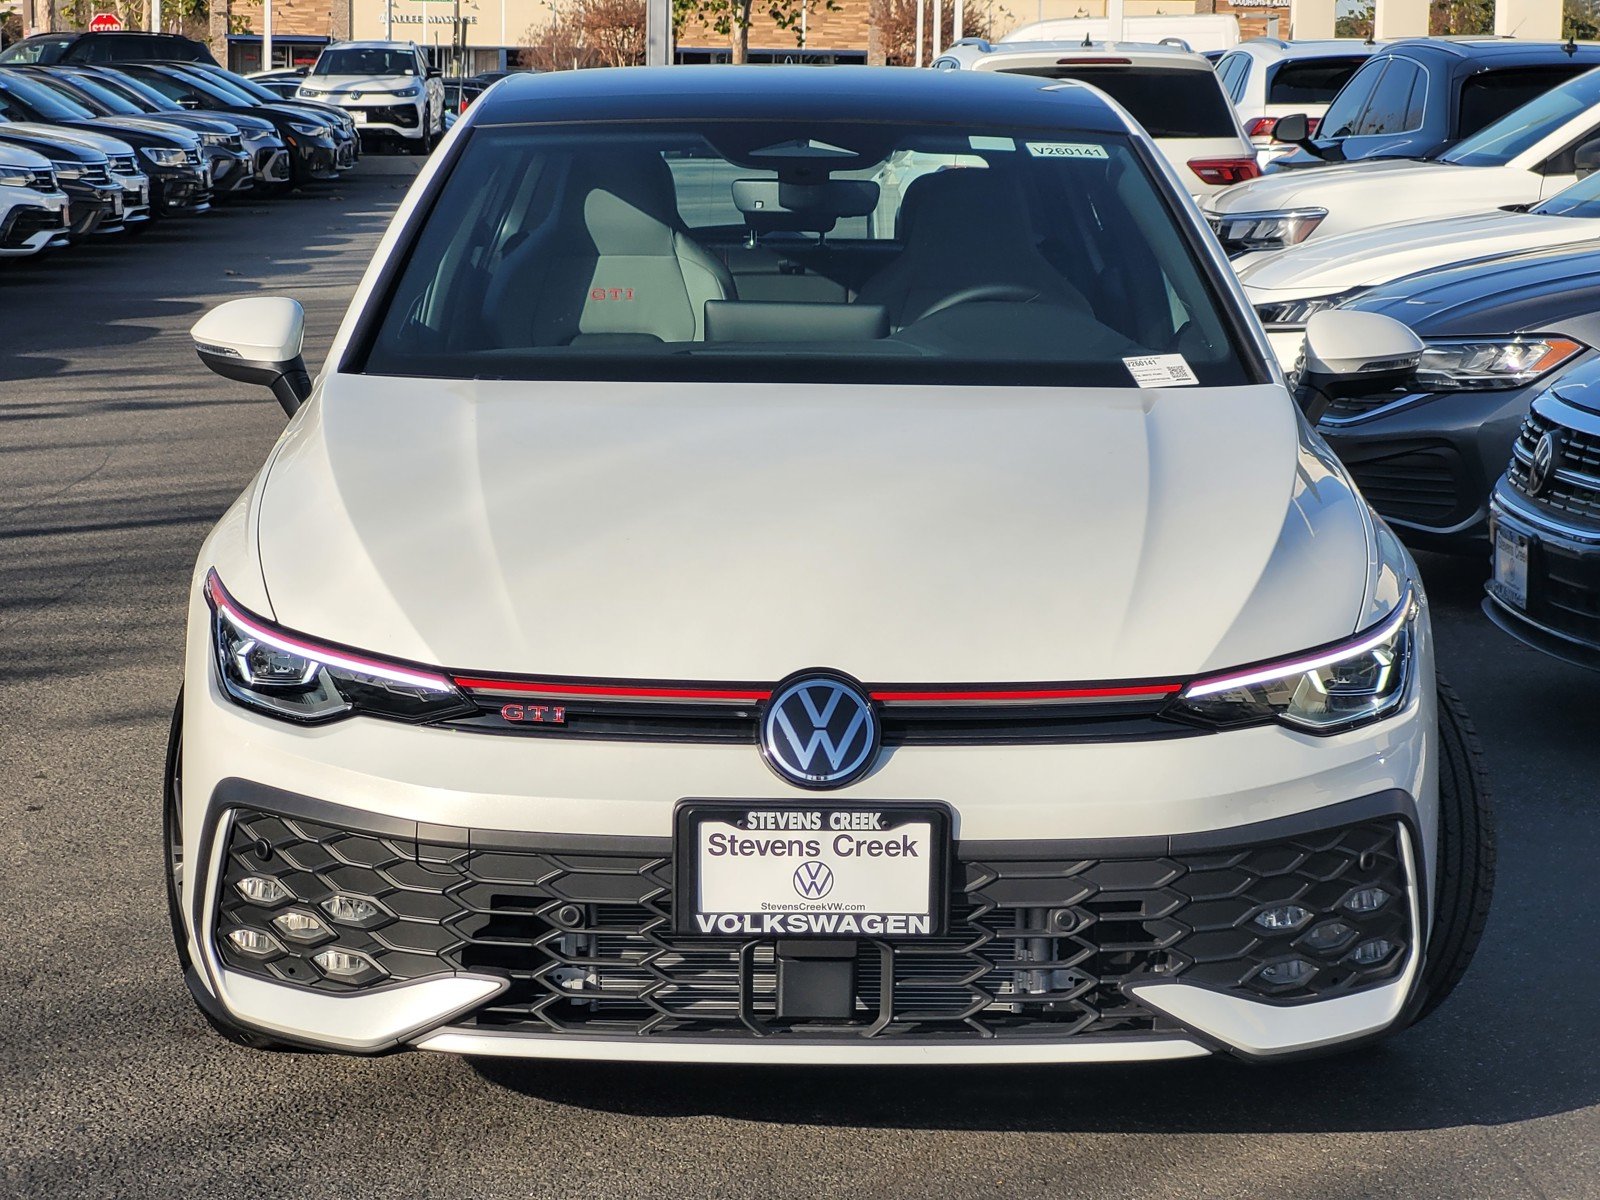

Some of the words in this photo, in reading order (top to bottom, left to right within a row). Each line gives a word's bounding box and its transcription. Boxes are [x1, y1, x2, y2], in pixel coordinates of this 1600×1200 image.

[1033, 147, 1102, 156] V260141
[591, 288, 633, 301] GTI
[501, 704, 565, 723] GTI
[773, 686, 868, 773] VW
[747, 812, 821, 830] STEVENS
[829, 812, 881, 830] CREEK
[708, 833, 821, 857] Stevens
[832, 834, 919, 858] Creek
[794, 862, 833, 899] VW
[760, 902, 866, 912] StevensCreekVW.com
[695, 914, 930, 934] VOLKSWAGEN
